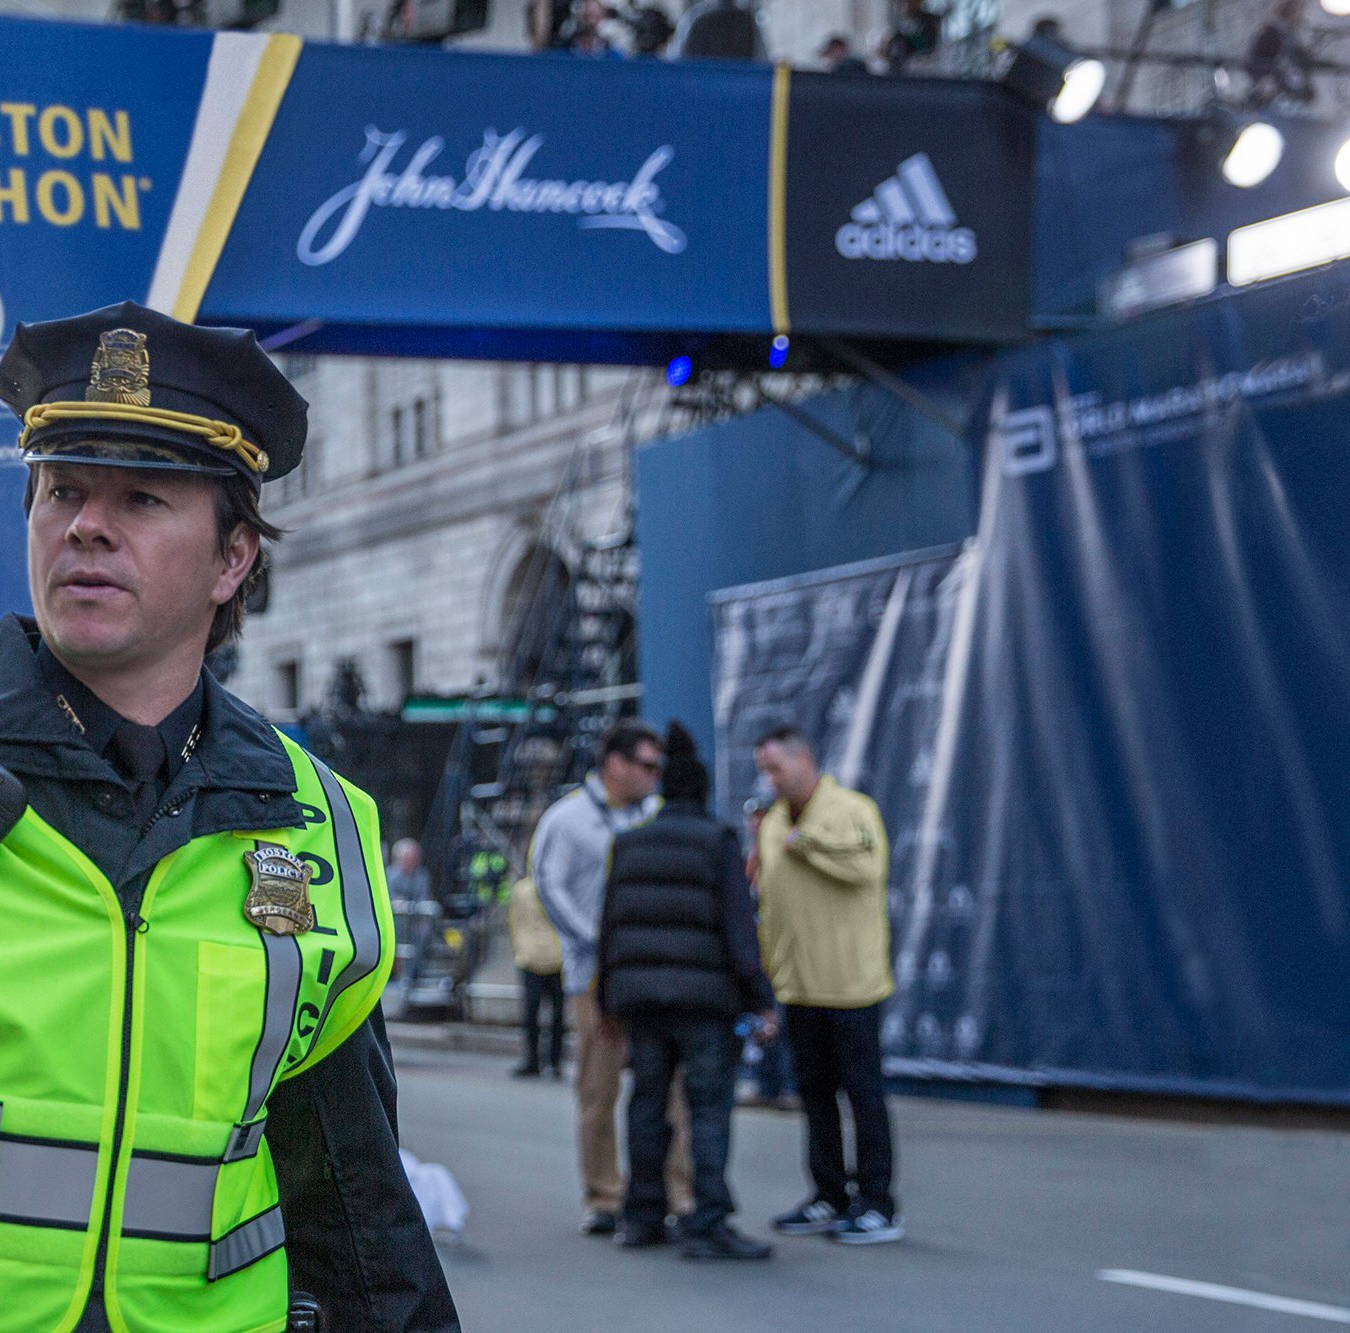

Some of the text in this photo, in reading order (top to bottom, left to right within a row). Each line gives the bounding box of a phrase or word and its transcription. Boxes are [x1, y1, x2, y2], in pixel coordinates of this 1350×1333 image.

[296, 123, 688, 266] John Hancock
[834, 222, 978, 264] adidas
[255, 848, 306, 872] BOSTON
[261, 863, 306, 881] POLICE
[284, 801, 340, 1068] POLIC
